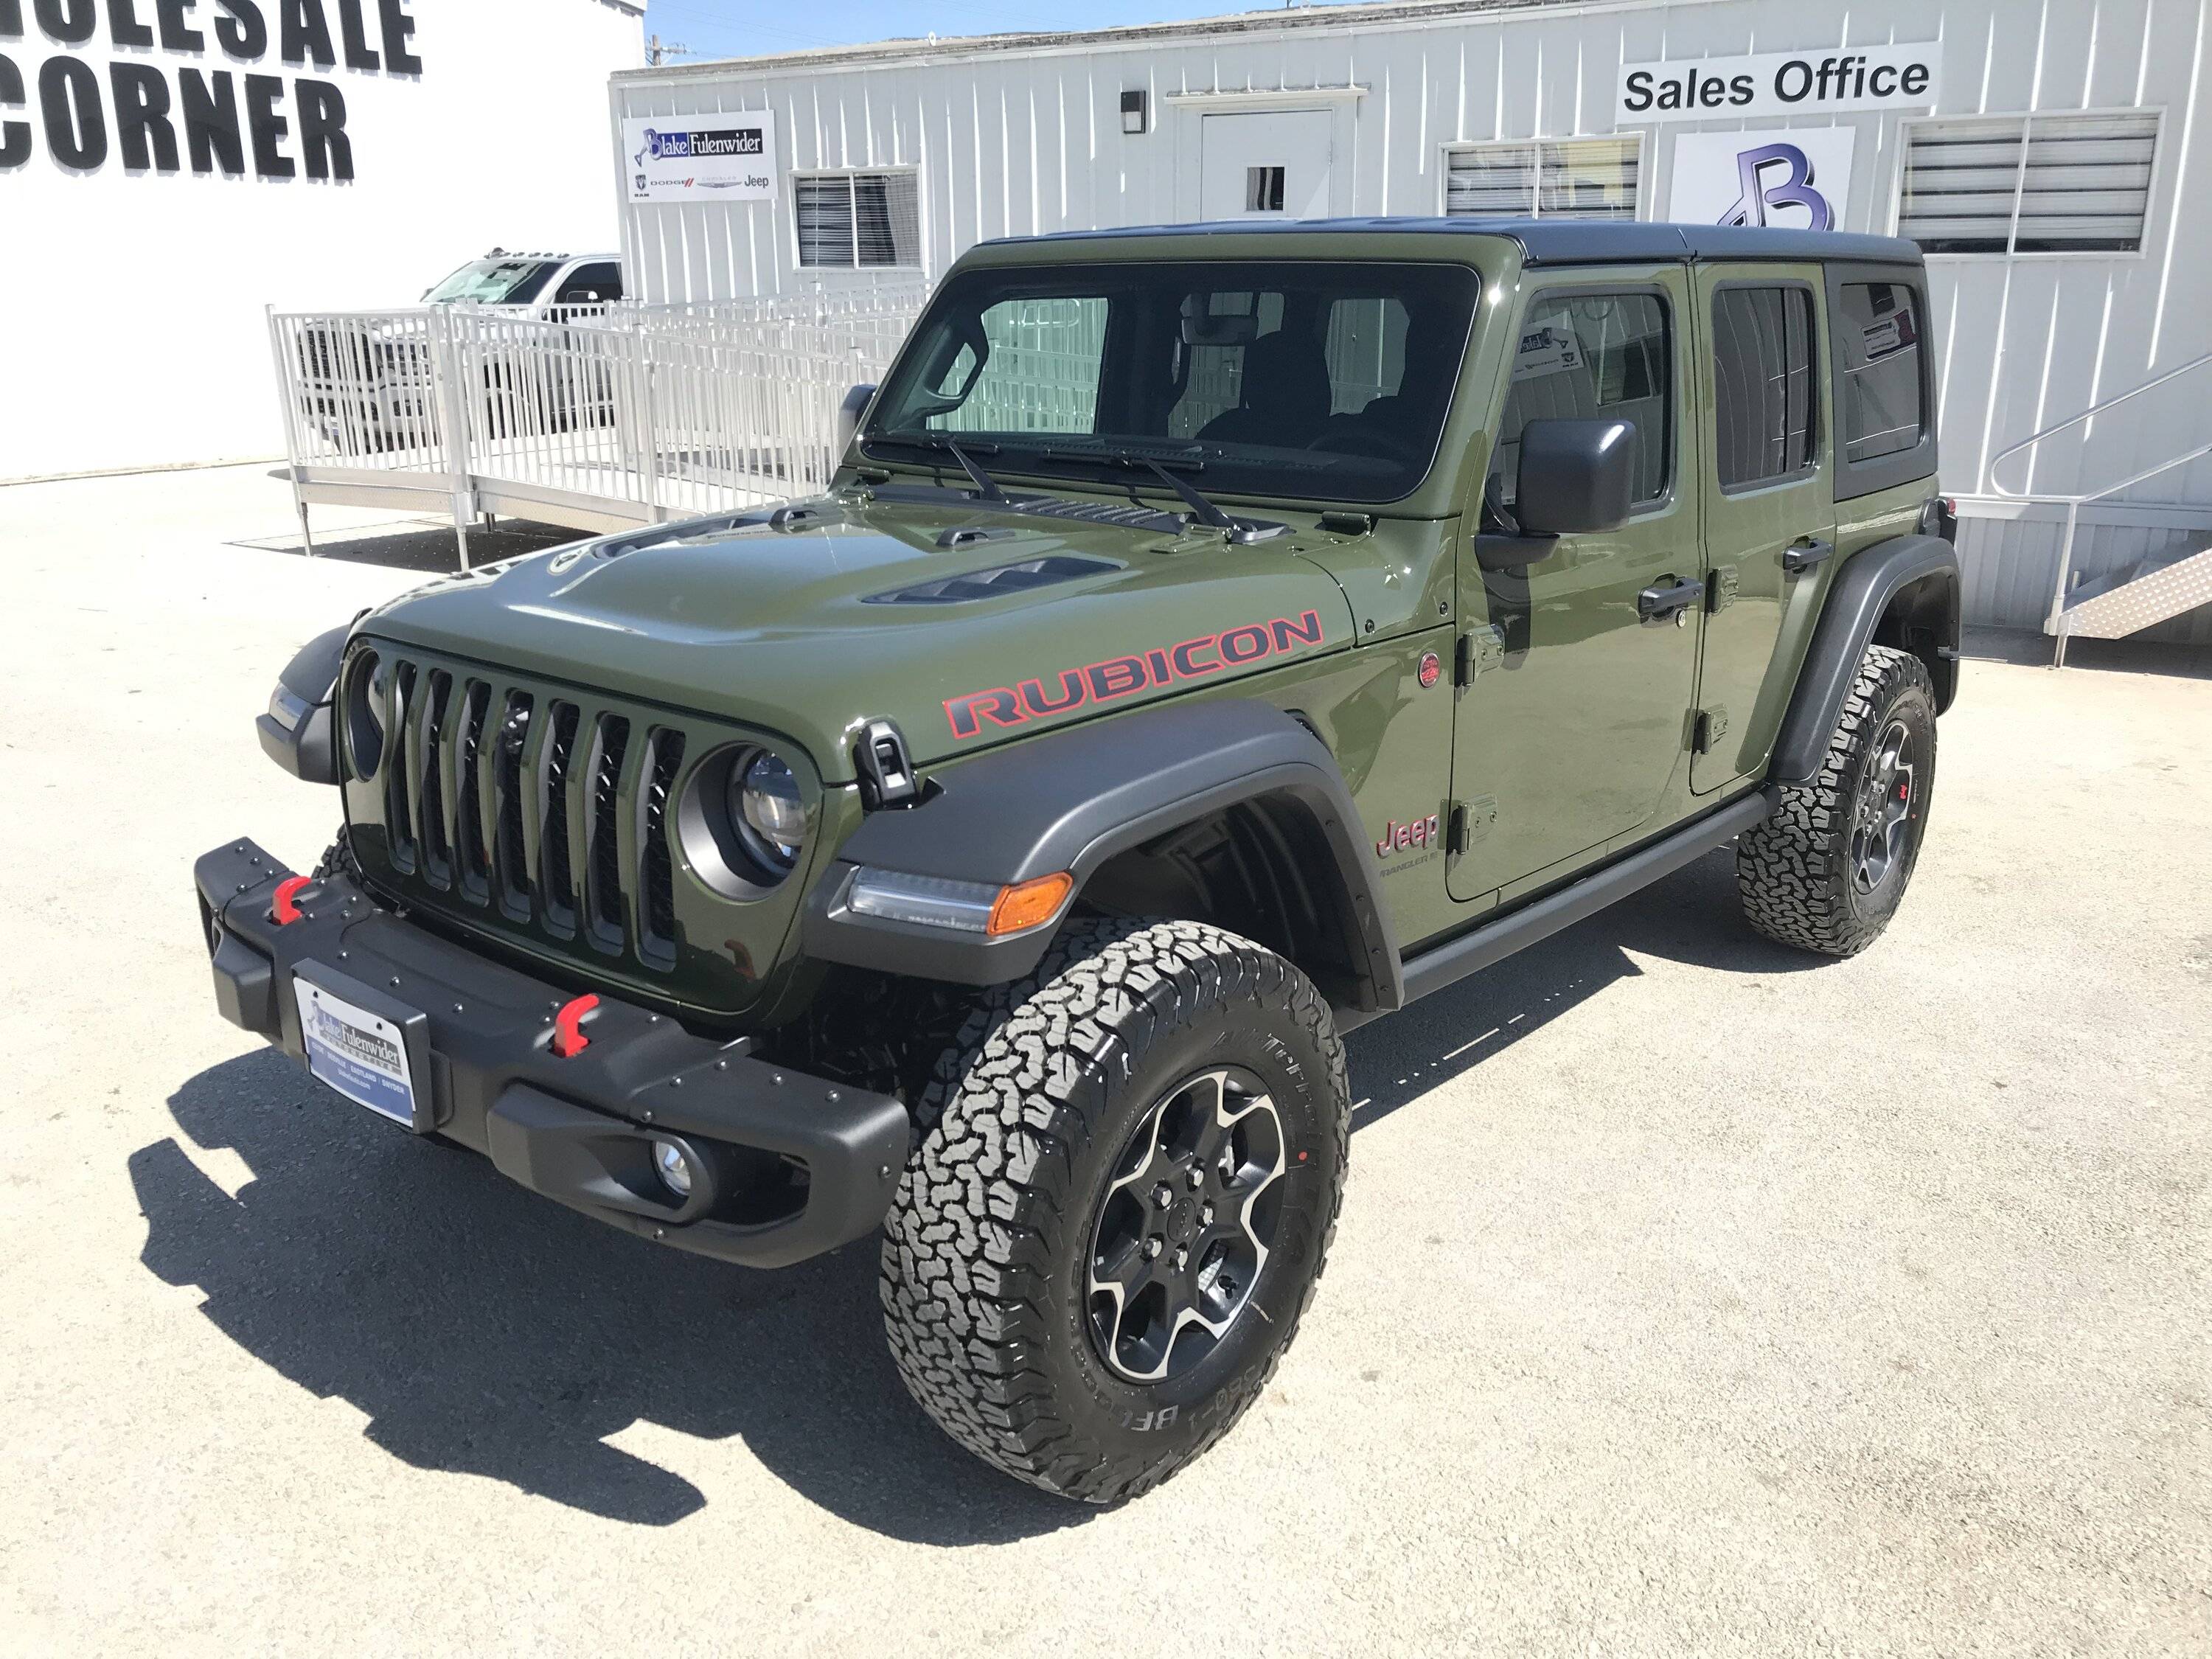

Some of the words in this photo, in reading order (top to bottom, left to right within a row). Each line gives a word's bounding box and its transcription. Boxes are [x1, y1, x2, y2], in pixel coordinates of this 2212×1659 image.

[1624, 68, 1754, 112] Sales
[1774, 56, 1930, 102] Office
[642, 128, 688, 161] Blake
[689, 132, 761, 154] Fulenwider
[744, 175, 769, 189] Jeep
[943, 609, 1325, 739] RUBICON
[1377, 813, 1440, 857] Jeep
[341, 1023, 398, 1065] Fulenwider
